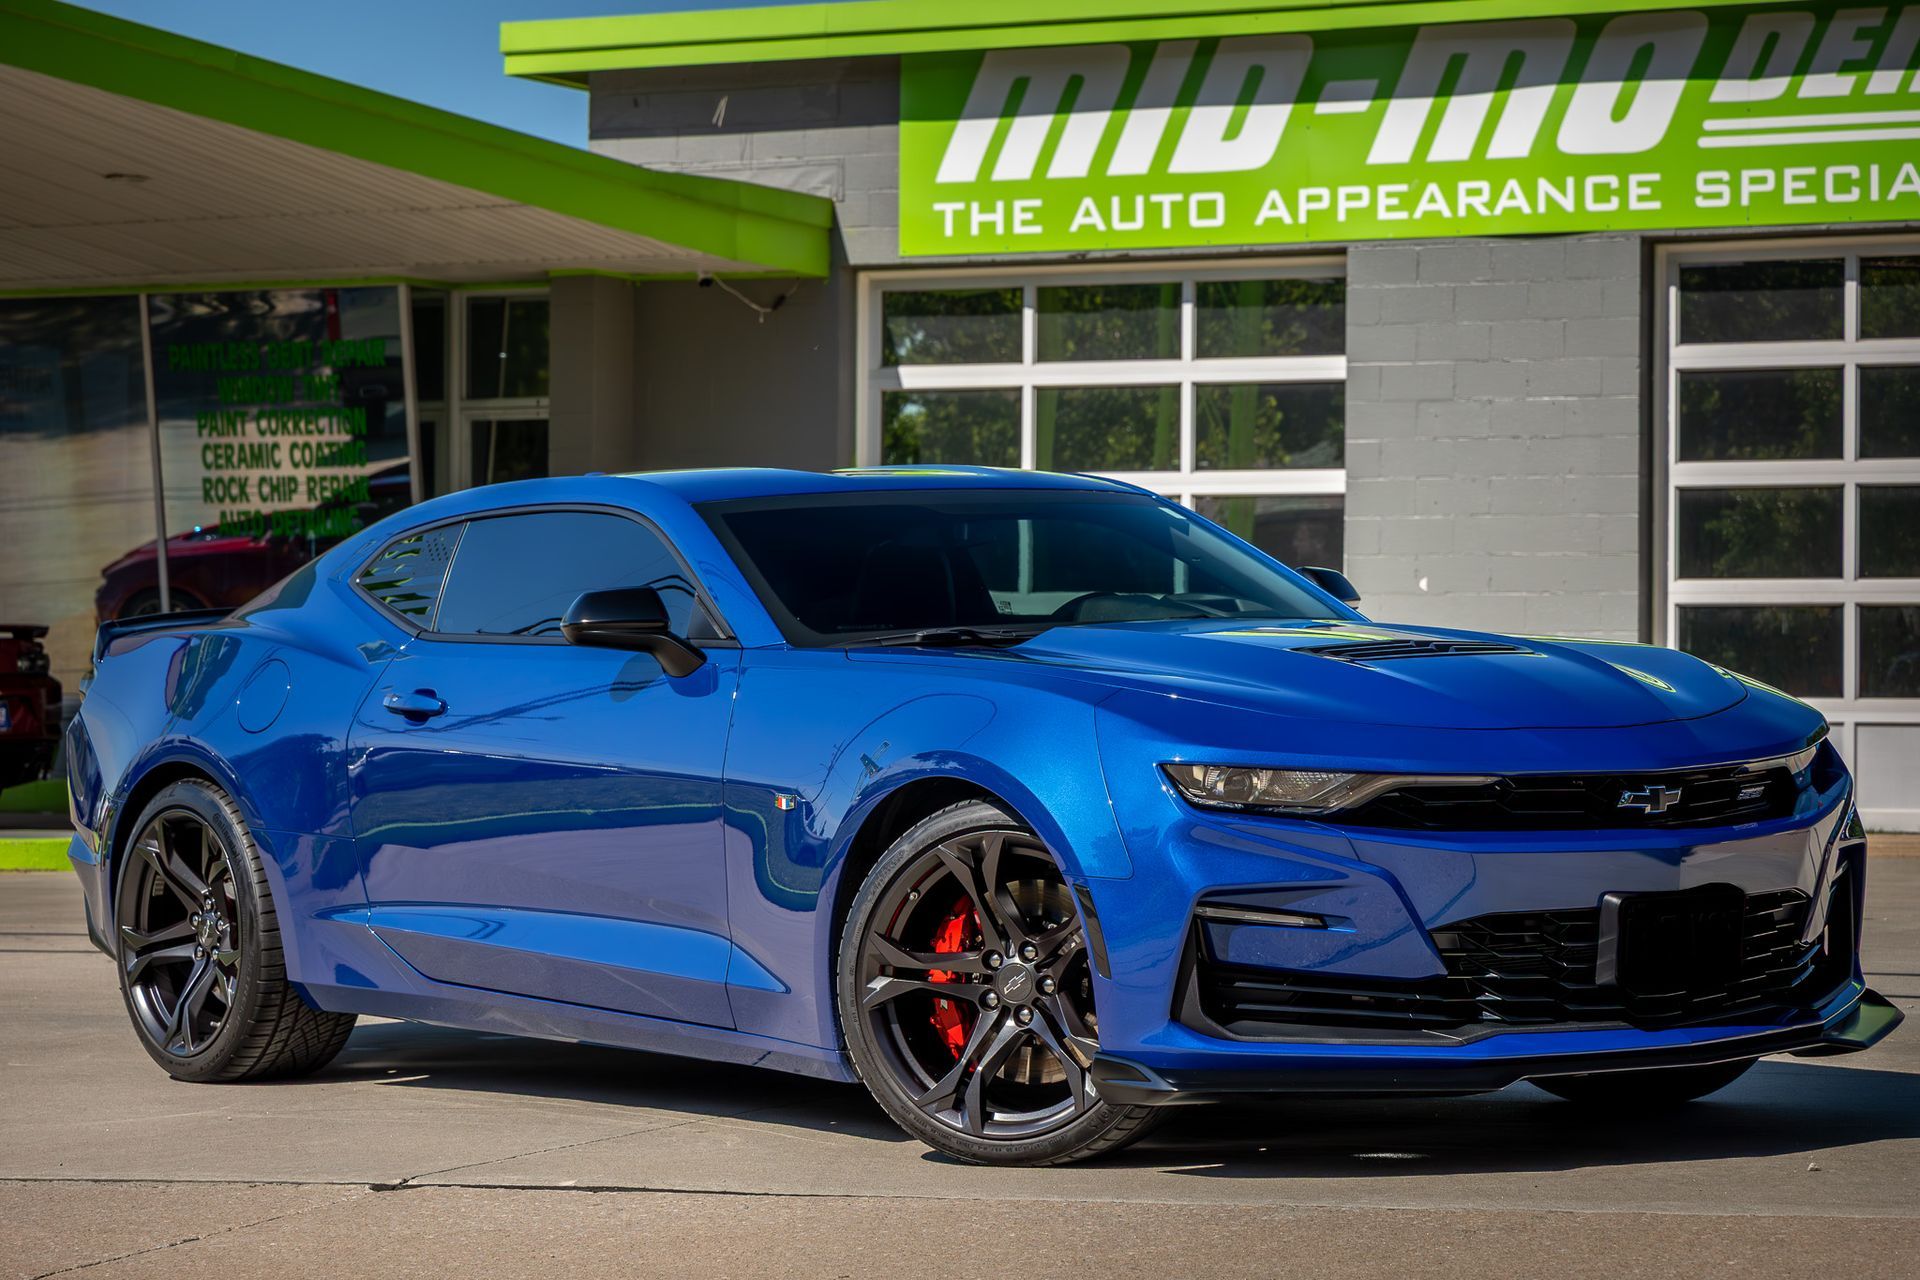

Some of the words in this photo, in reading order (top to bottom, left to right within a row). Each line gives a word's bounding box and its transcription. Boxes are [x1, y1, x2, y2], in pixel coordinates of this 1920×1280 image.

[935, 11, 1709, 184] MID-MO
[932, 198, 1044, 237] THE
[1069, 191, 1226, 233] AUTO
[1253, 172, 1662, 227] APPEARANCE
[1694, 162, 1920, 209] SPECIA
[168, 340, 261, 372] PAINTLESS
[196, 411, 249, 438] PAINT
[255, 406, 368, 437] CORRECTION
[201, 442, 282, 470] CERAMIC
[289, 439, 369, 468] COATING
[202, 475, 251, 504] ROCK
[257, 475, 299, 503] CHIP
[306, 473, 371, 502] REPAIR
[219, 510, 266, 538] AUTO
[272, 507, 362, 538] DETAILING
